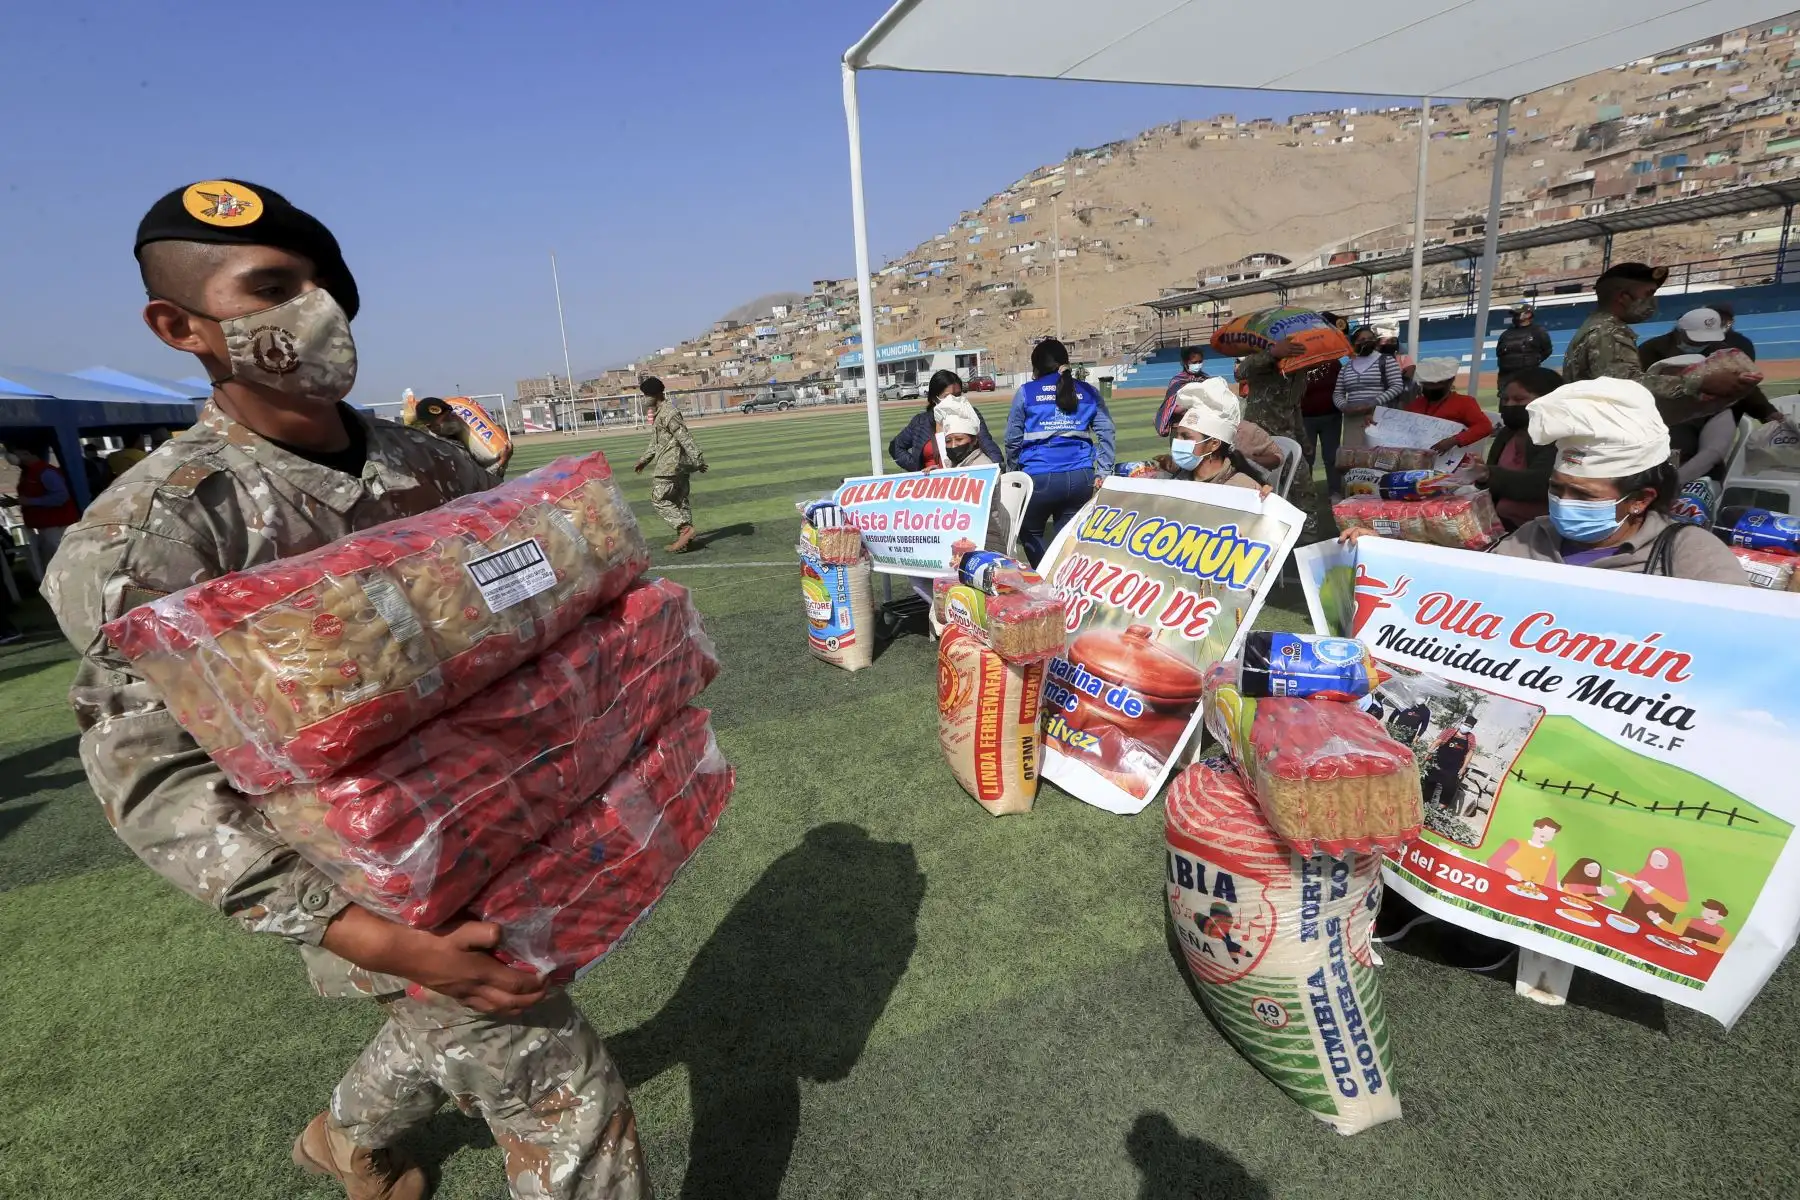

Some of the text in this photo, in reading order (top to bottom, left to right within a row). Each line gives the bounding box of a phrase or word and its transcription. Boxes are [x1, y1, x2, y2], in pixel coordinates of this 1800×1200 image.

[881, 343, 917, 357] MUNICIPAL
[840, 475, 984, 506] OLLA COMÚN
[893, 508, 971, 531] Florida
[896, 535, 941, 544] SUBGERENCIAL
[1129, 518, 1270, 589] COMÚN
[900, 557, 943, 569] PACHACAMAC
[1058, 555, 1217, 637] ORAZON DE
[1415, 592, 1694, 683] Olla Común
[1049, 657, 1143, 717] uarina de
[1376, 624, 1697, 731] Natividad de Maria
[1045, 681, 1078, 711] mac
[1044, 712, 1099, 749] álvez
[1621, 722, 1685, 752] Mz.F
[980, 752, 999, 795] LINDA
[1410, 850, 1435, 872] del
[1435, 863, 1490, 893] 2020
[1176, 924, 1216, 959] EÑA
[1256, 1005, 1280, 1019] 49
[1263, 1017, 1280, 1026] Kg
[1325, 917, 1383, 1095] SUPERIOR
[1307, 966, 1359, 1098] CUMBIA
